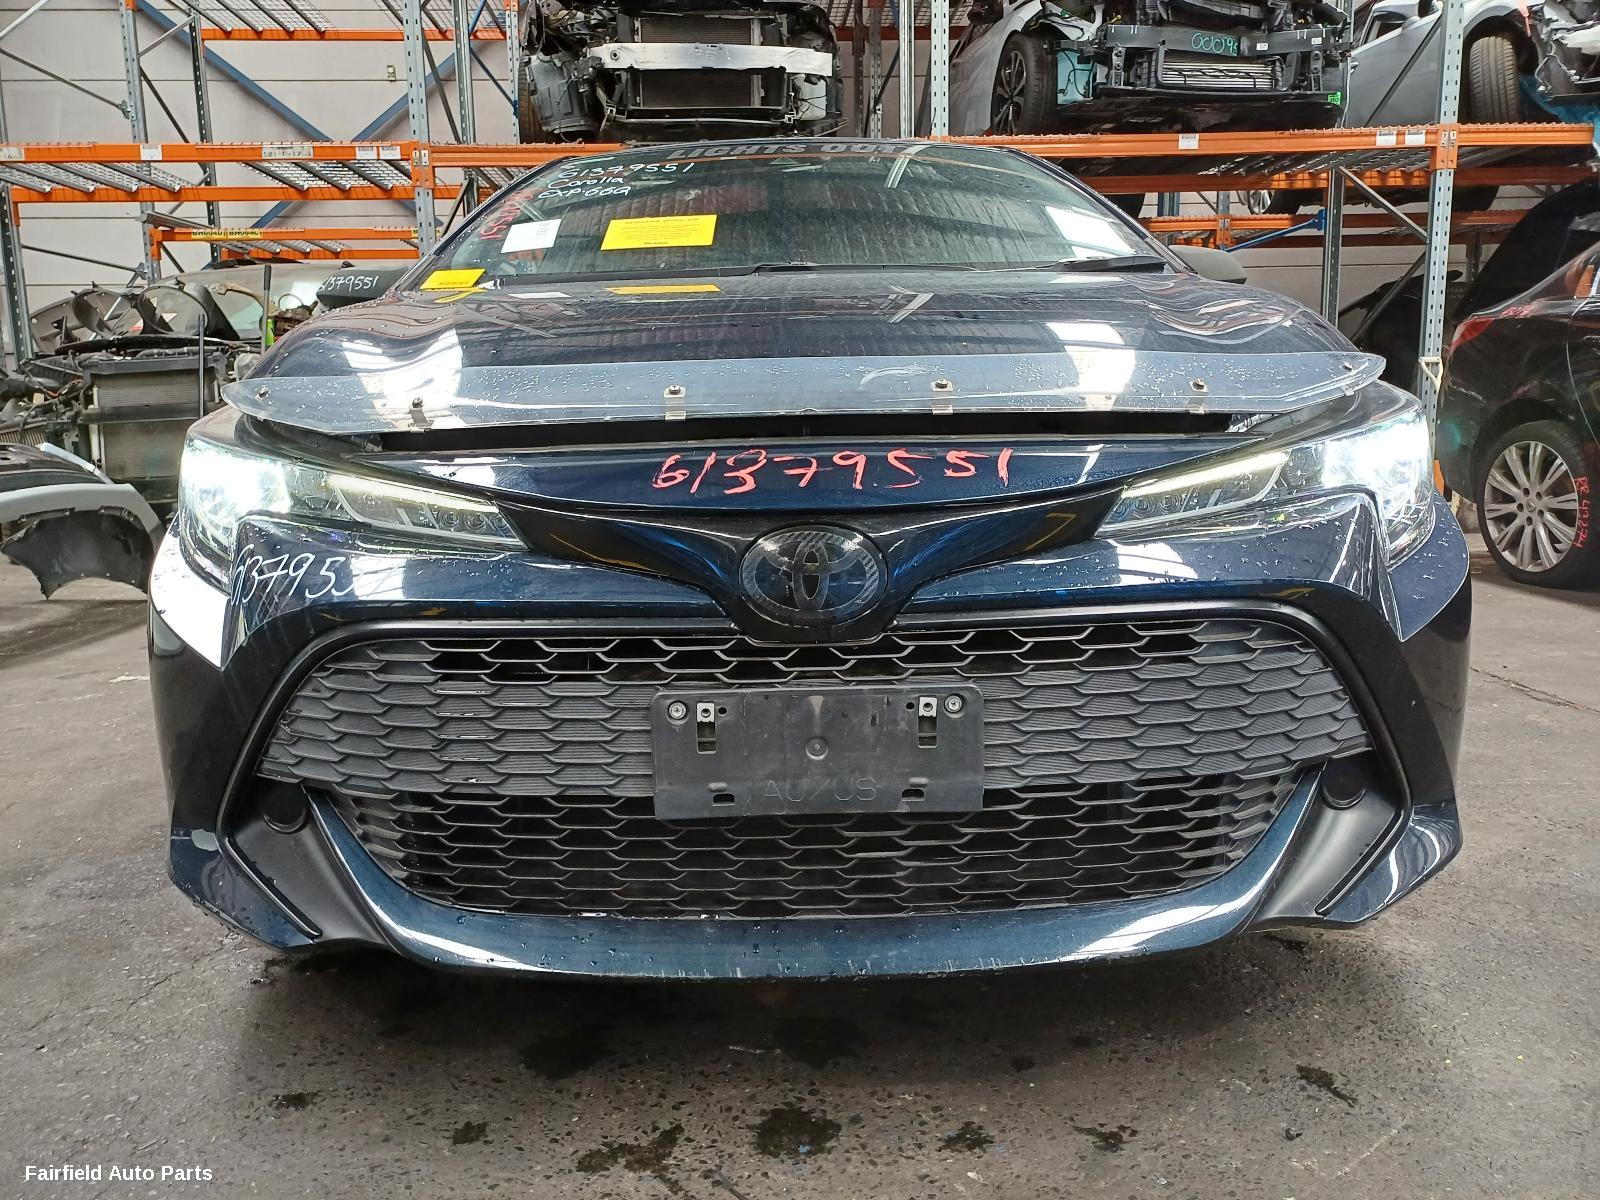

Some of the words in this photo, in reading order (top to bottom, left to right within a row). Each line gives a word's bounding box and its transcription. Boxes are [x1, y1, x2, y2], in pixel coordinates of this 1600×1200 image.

[667, 143, 807, 160] LIGHTS
[548, 176, 624, 189] Corolla
[652, 447, 1014, 494] 61379551
